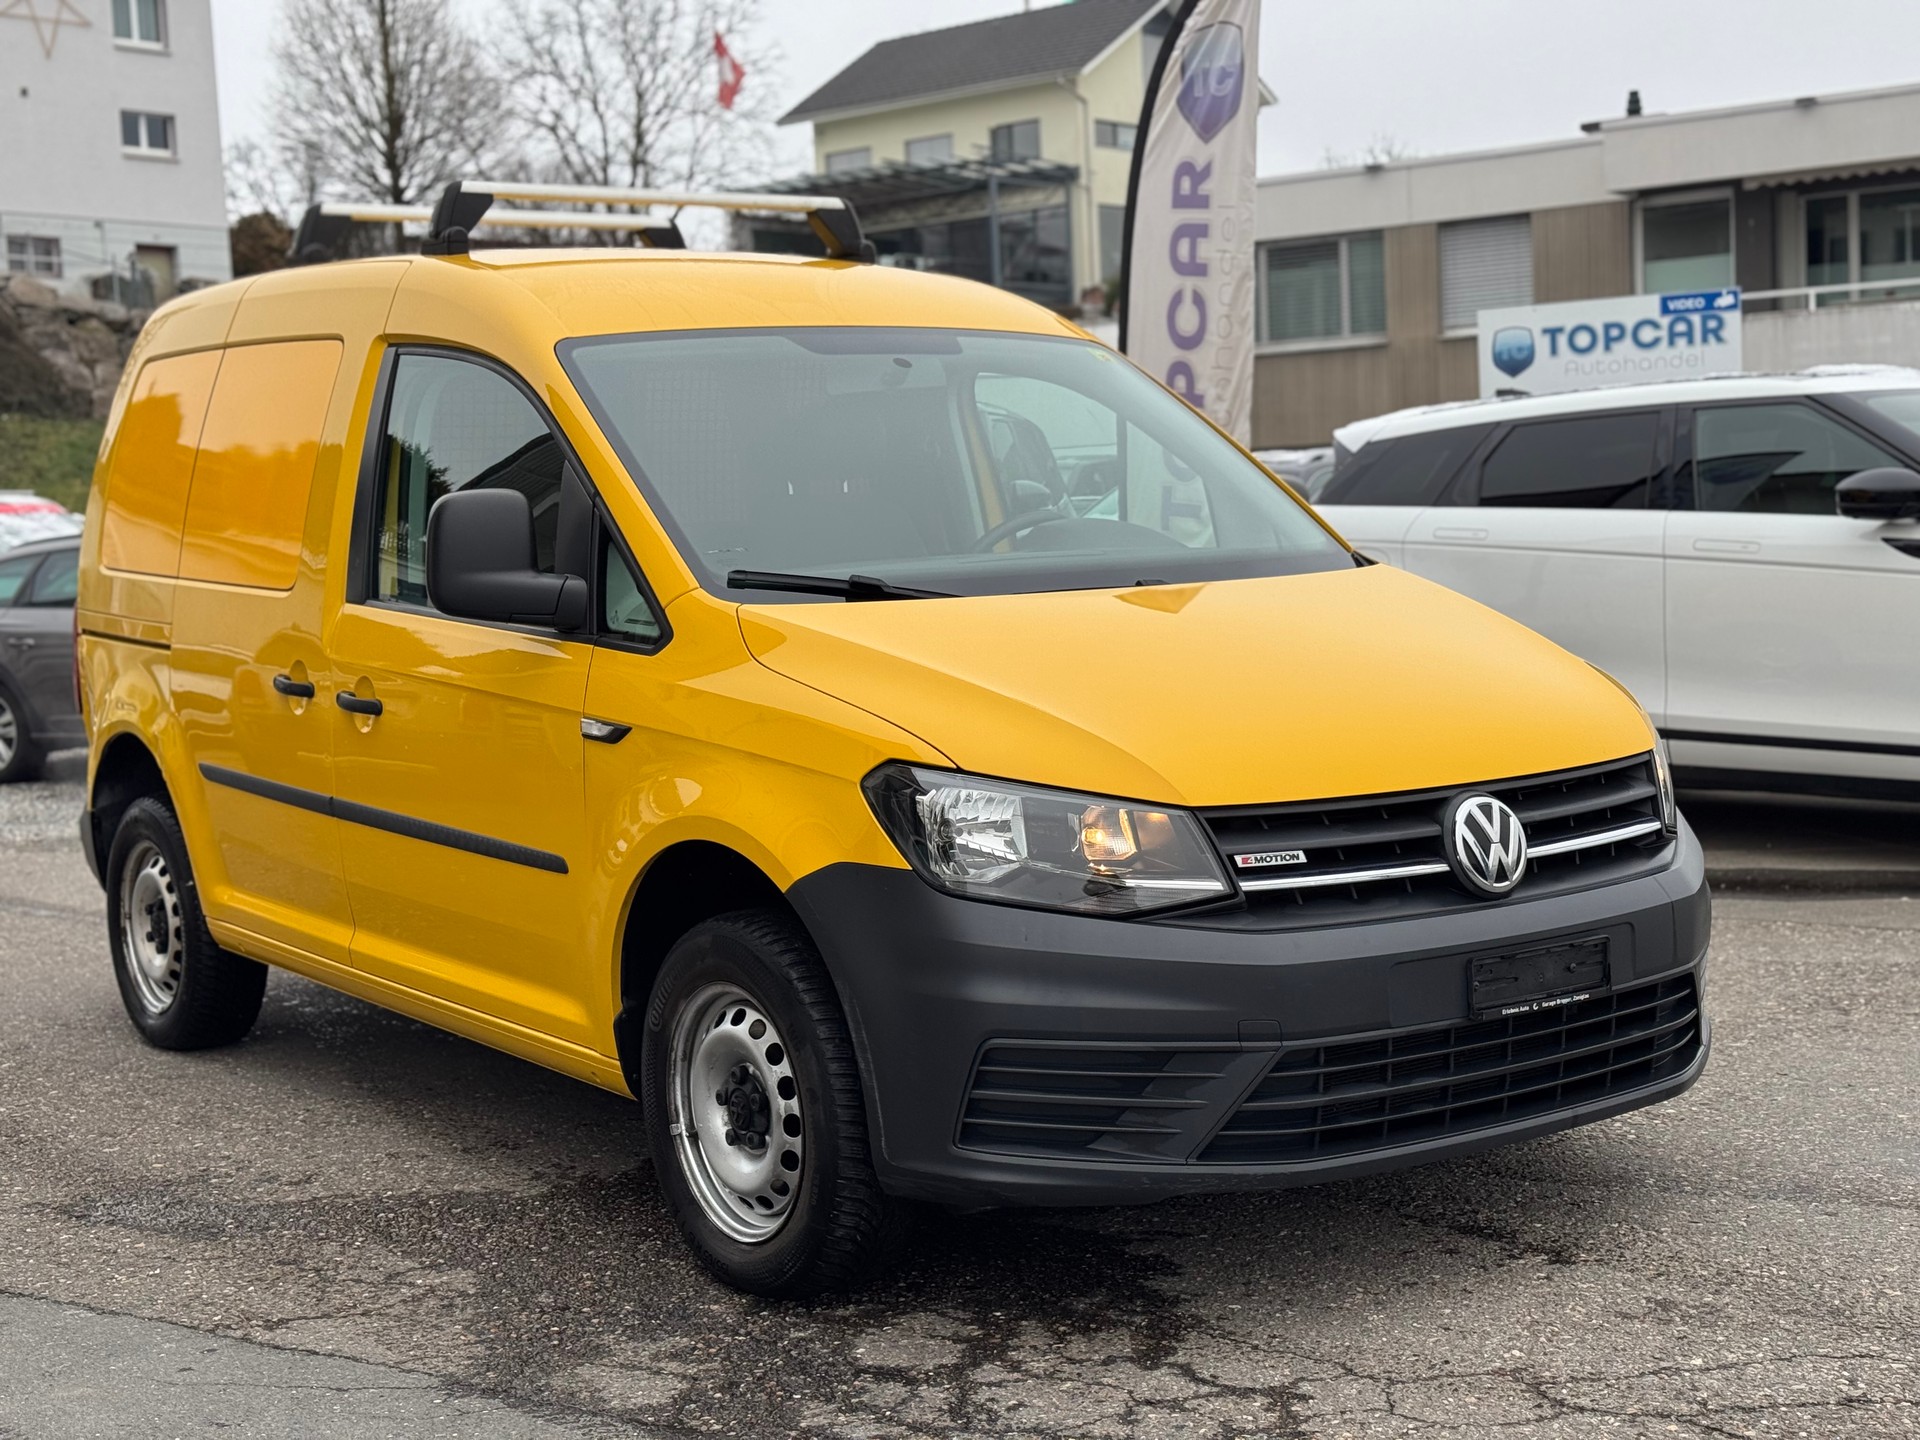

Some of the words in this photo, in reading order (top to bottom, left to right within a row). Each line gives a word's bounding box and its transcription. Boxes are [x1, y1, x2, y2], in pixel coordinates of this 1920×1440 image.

[1667, 297, 1705, 311] VIDEO
[1542, 314, 1726, 356] TOPCAR
[1564, 350, 1705, 376] Autohandel
[1241, 853, 1300, 865] 4MOTION
